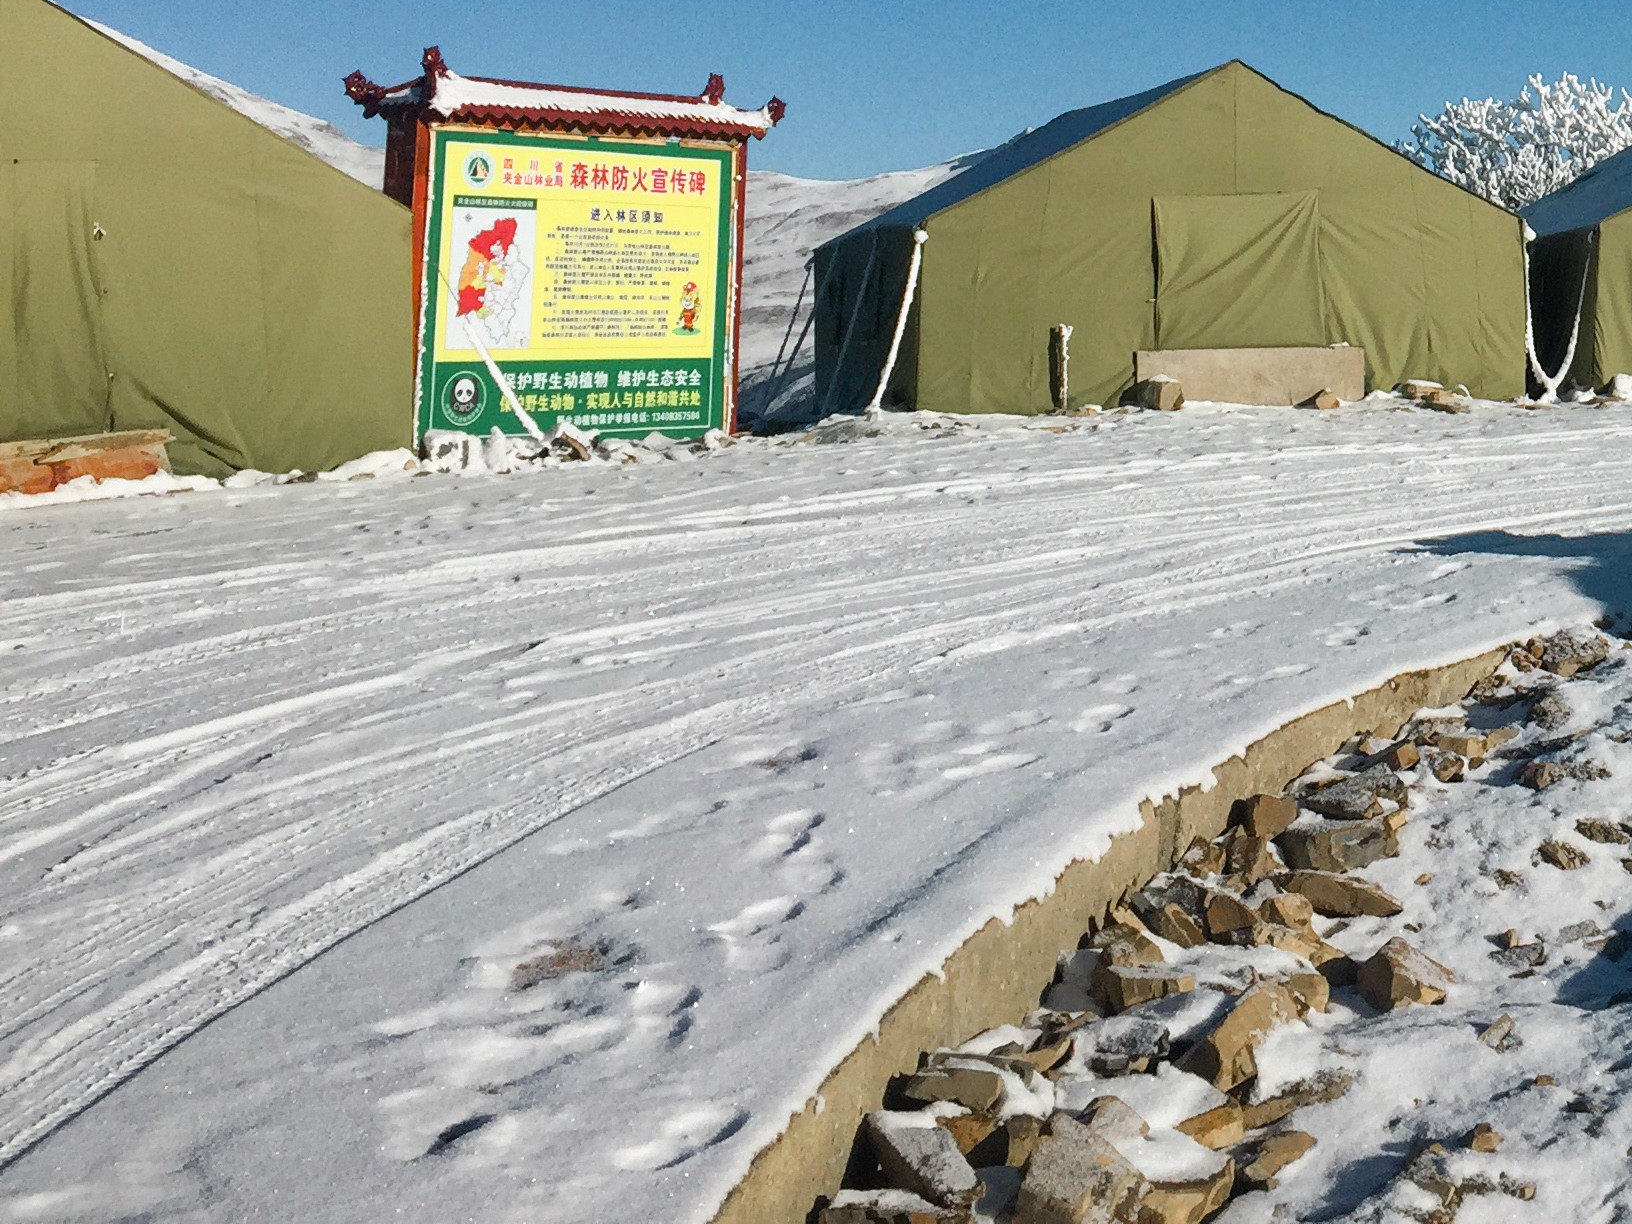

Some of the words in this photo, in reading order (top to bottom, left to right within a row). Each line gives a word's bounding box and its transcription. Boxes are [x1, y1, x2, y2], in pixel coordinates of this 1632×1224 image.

[570, 162, 706, 196] 森林防火宣传碑
[590, 207, 664, 223] 进入林区须知
[617, 368, 702, 388] 维护生态安全
